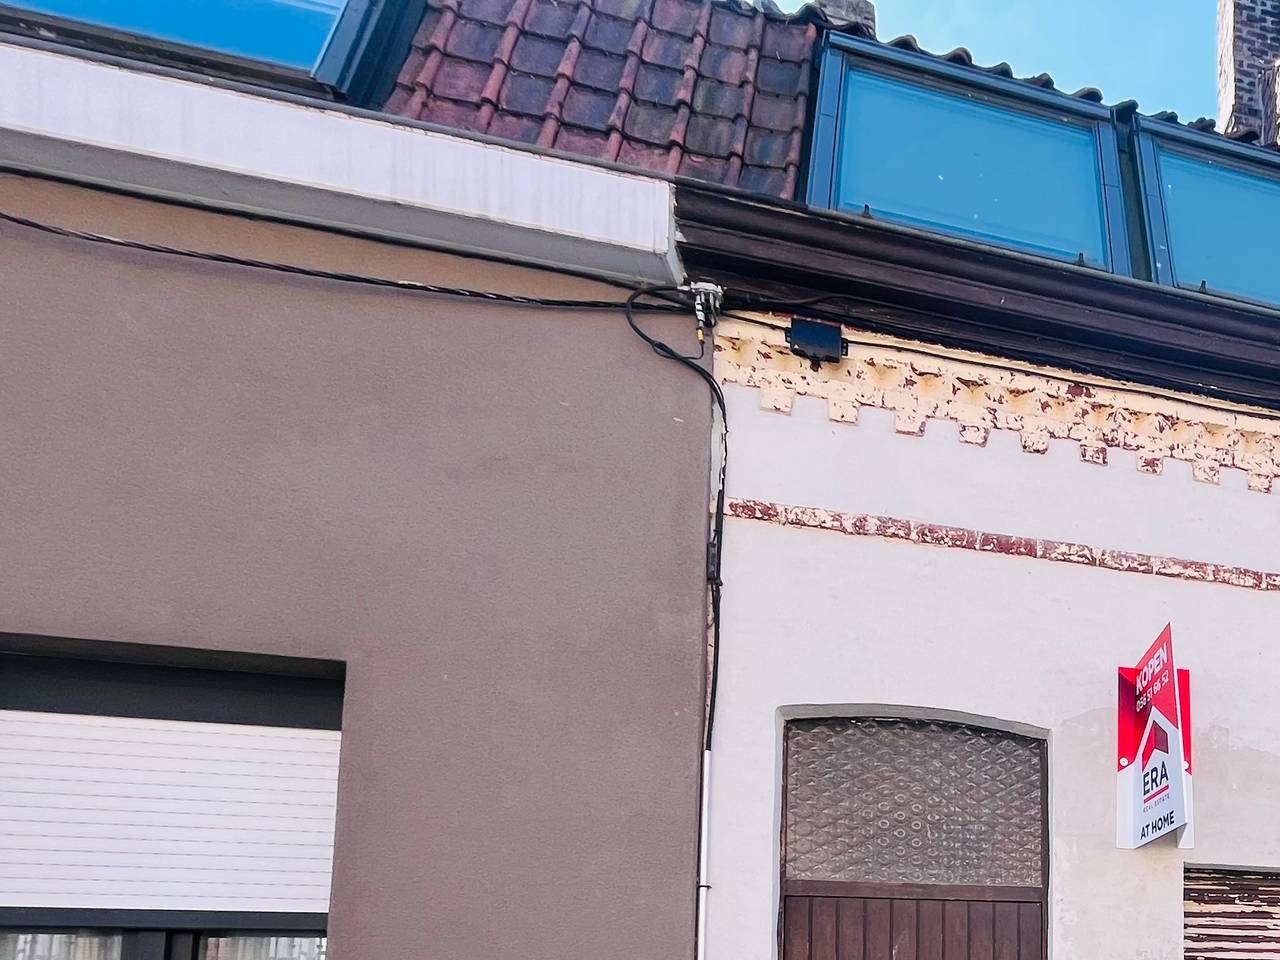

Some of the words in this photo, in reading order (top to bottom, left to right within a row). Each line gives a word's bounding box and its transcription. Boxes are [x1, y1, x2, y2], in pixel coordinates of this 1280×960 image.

[1136, 642, 1167, 695] KOPEN
[1143, 761, 1169, 796] ERA
[1140, 823, 1150, 840] AT
[1151, 810, 1175, 834] HOME
